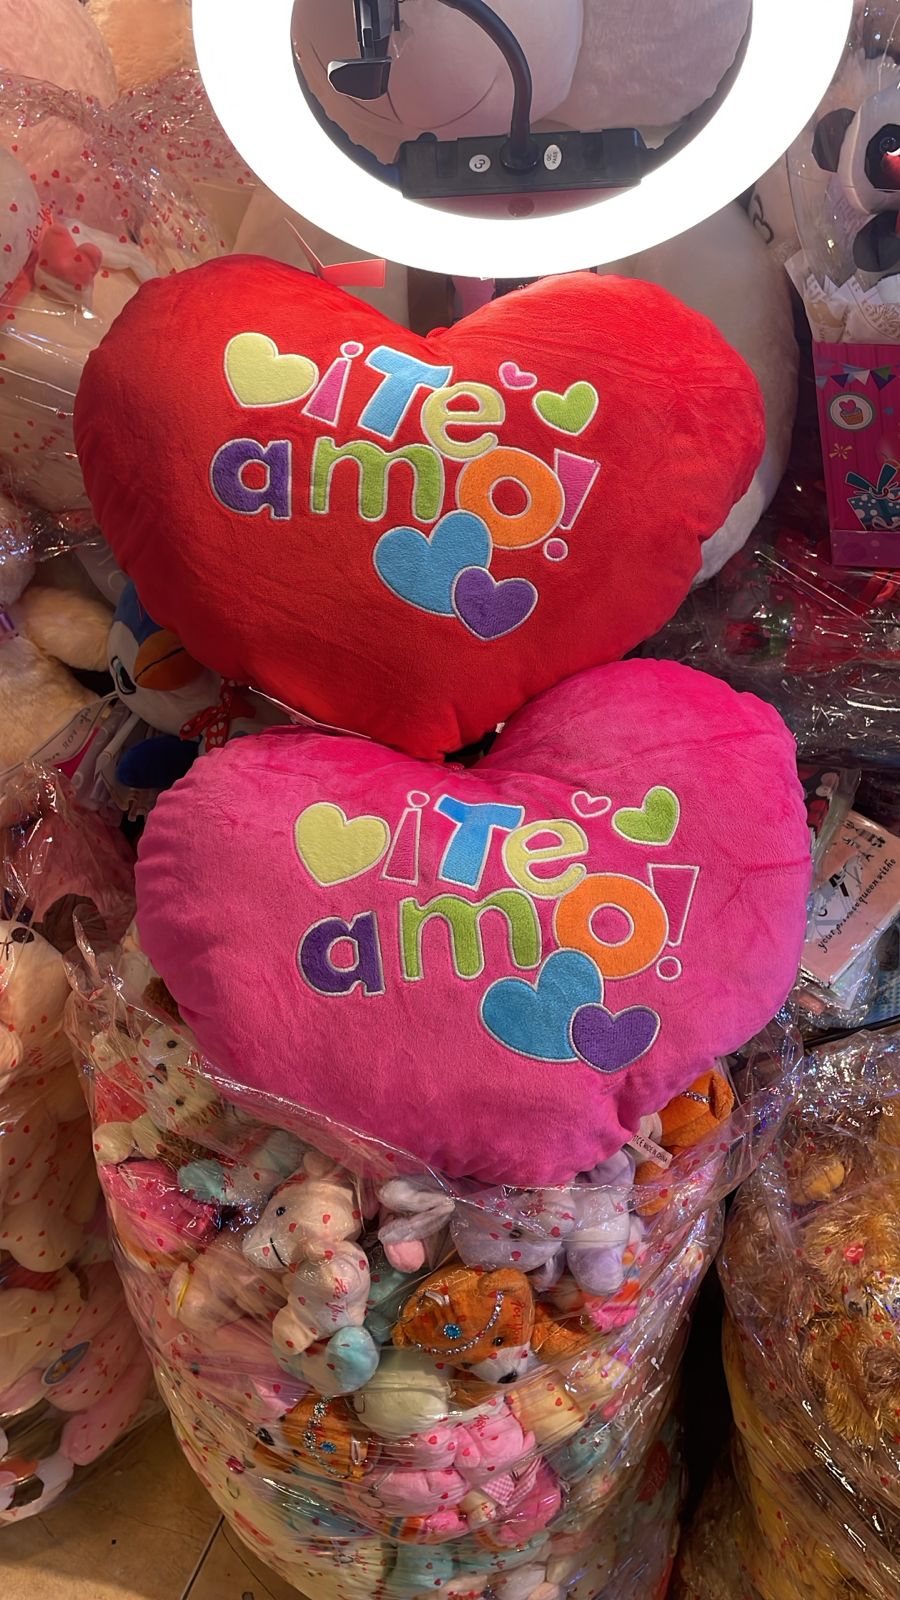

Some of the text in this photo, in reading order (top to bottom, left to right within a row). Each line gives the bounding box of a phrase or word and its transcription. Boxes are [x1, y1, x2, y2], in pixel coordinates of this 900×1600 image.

[818, 930, 836, 954] your
[858, 879, 880, 905] queen
[656, 1151, 668, 1163] CHINA
